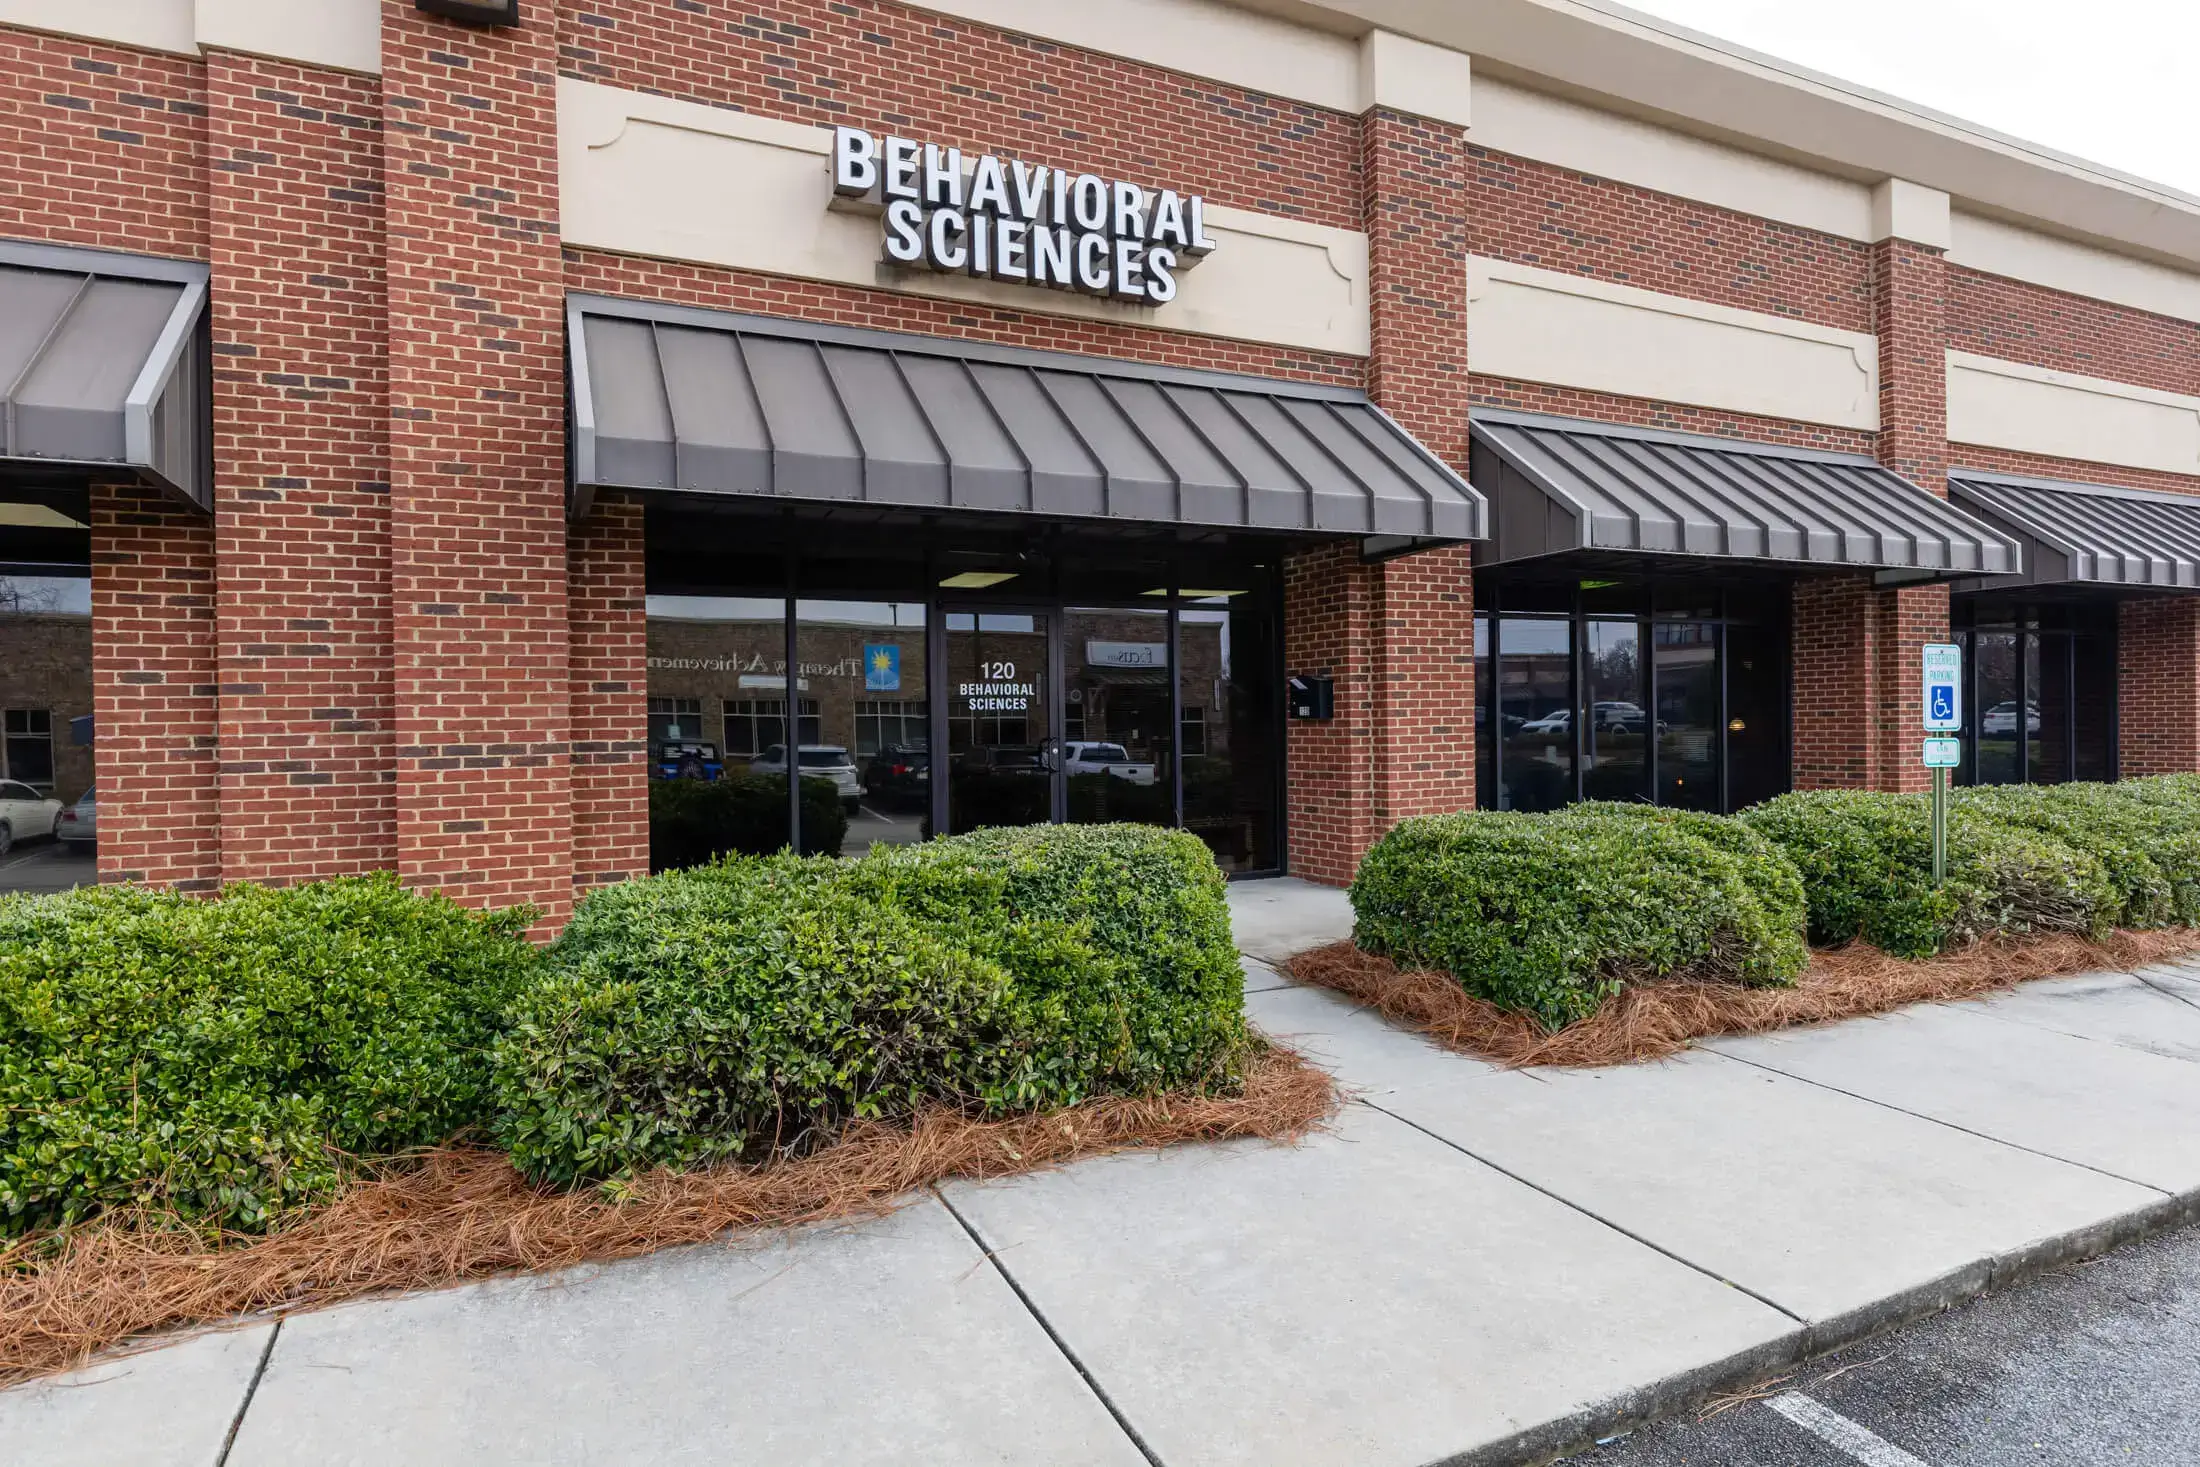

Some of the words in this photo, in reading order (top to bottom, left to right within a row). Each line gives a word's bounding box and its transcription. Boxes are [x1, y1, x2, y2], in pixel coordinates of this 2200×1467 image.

[834, 126, 1216, 251] BEHAVIORAL
[885, 200, 1177, 302] SCIENCES
[1927, 653, 1956, 666] RESERVED
[981, 662, 1015, 680] 120
[1929, 670, 1954, 682] PARKING
[960, 683, 1035, 696] BEHAVIORAL
[969, 697, 1027, 710] SCIENCES
